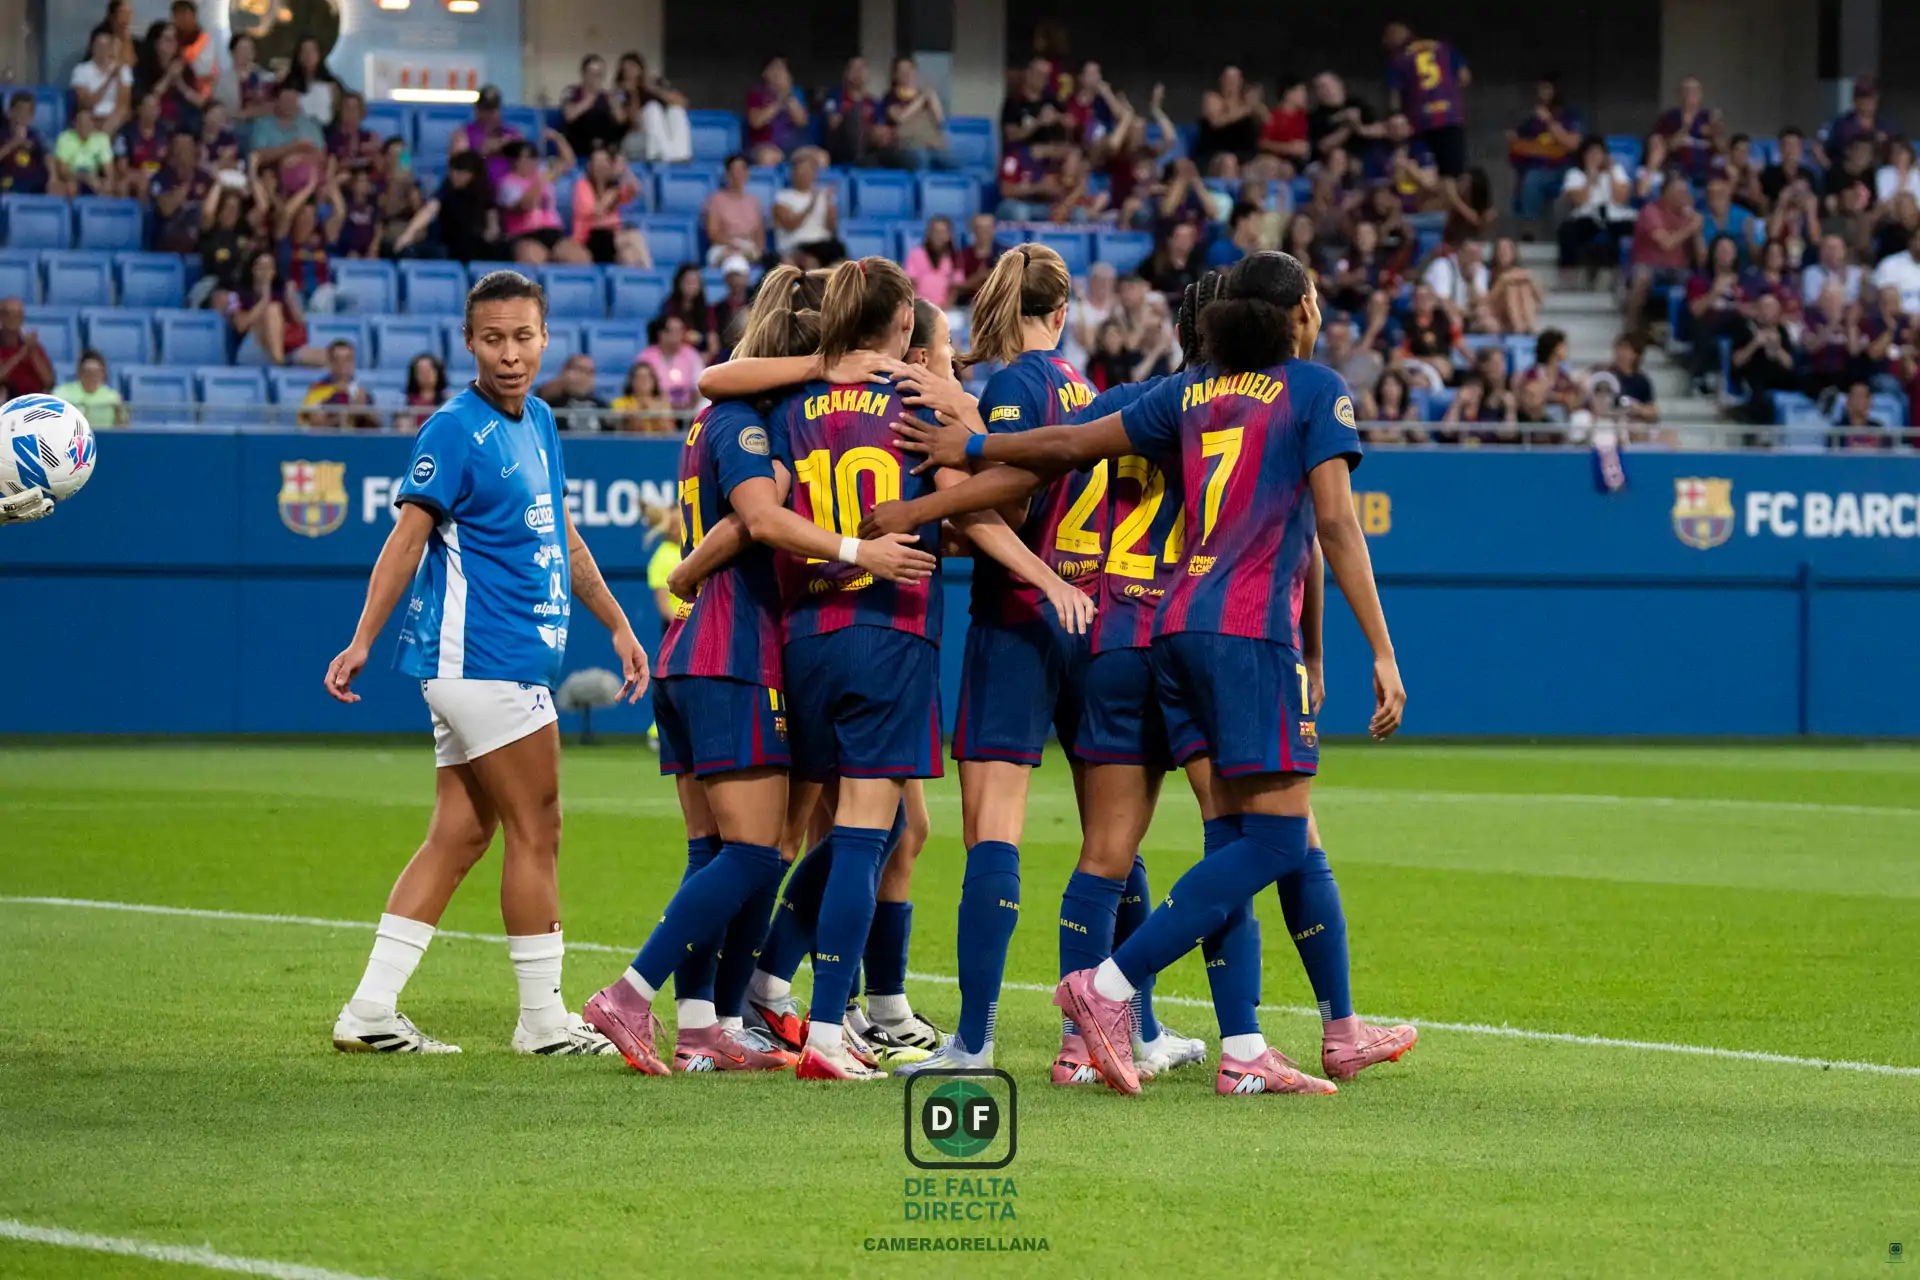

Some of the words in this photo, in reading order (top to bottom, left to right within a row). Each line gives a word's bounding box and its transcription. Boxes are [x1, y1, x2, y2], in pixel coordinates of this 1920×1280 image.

[1416, 51, 1440, 90] 5
[804, 390, 890, 420] GRAHAM
[1058, 382, 1097, 412] PAR
[1182, 371, 1284, 412] PARALLUELO
[990, 407, 1020, 420] IMBO
[794, 446, 900, 564] 10
[1201, 426, 1244, 546] 7
[1745, 491, 1798, 537] FC
[1804, 492, 1920, 538] BARC
[999, 898, 1020, 912] BAR
